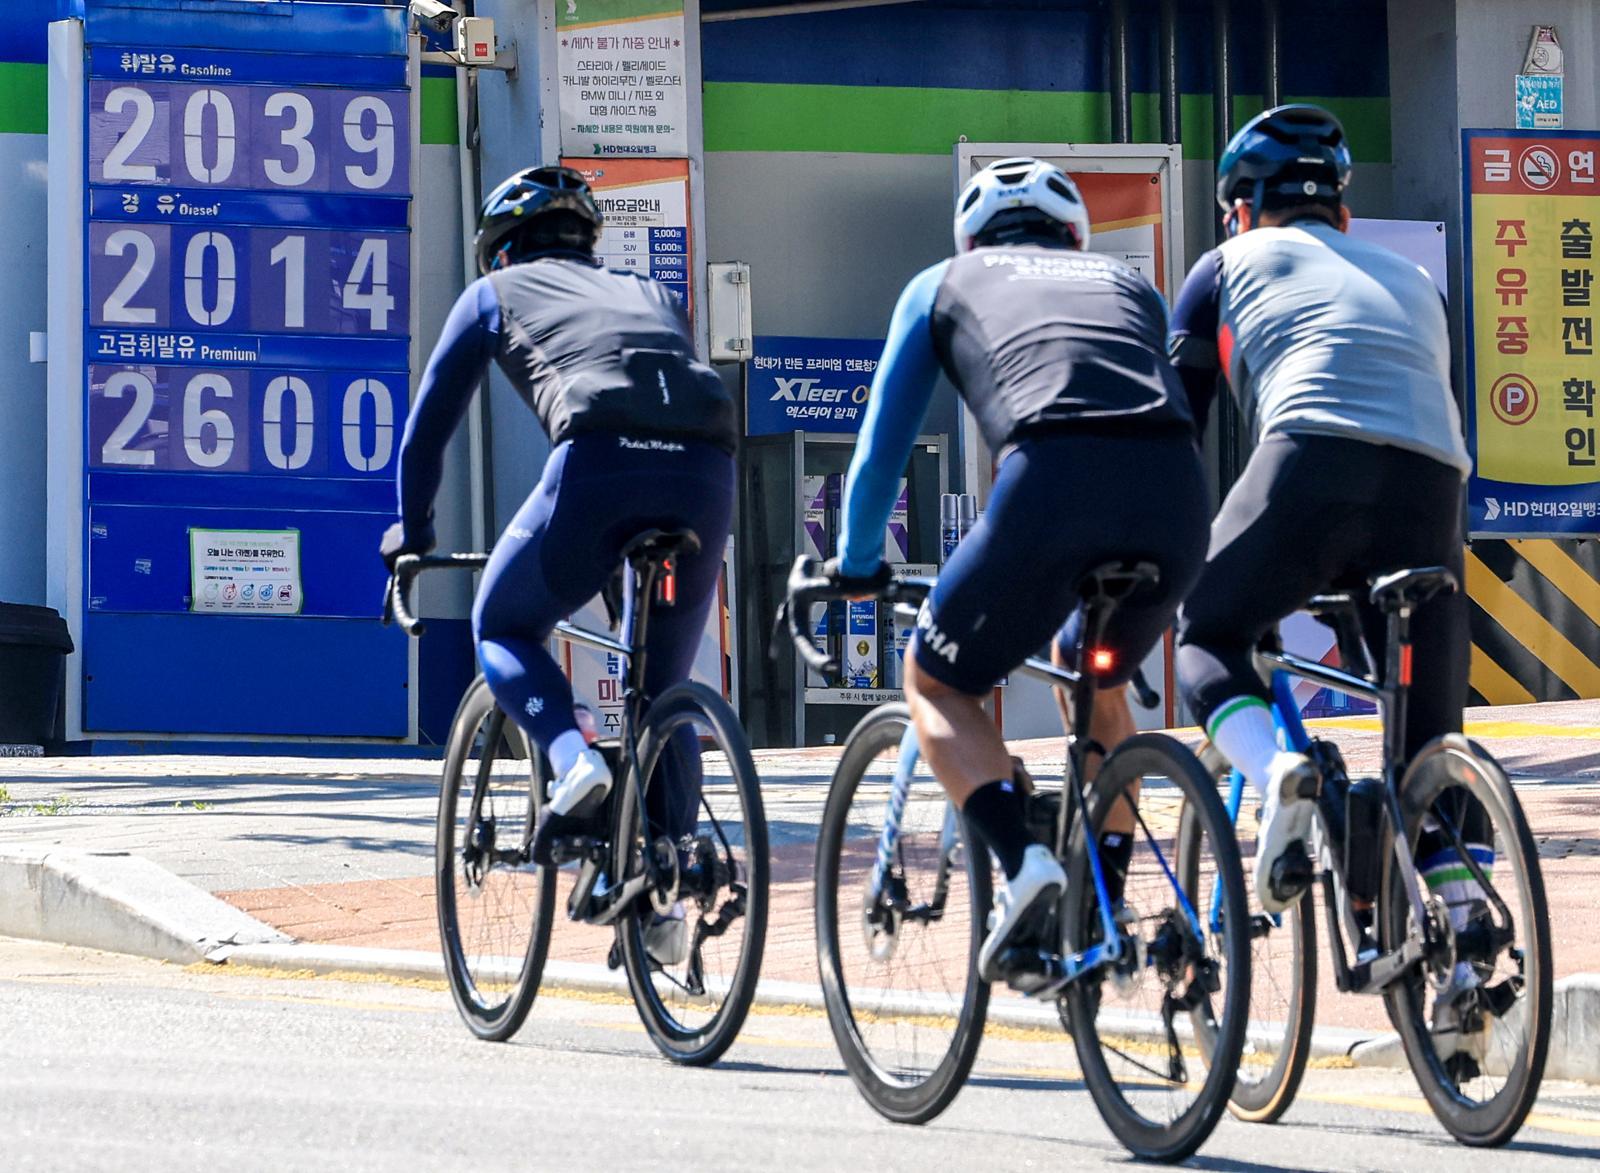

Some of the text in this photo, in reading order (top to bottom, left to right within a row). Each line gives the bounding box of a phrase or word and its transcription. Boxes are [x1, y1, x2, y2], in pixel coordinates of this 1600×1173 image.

[571, 37, 671, 49] 세차 불가 차종 안내
[120, 52, 232, 77] 휘발유 Gasoline
[577, 61, 613, 71] 스타리아
[563, 76, 590, 86] 카니발
[593, 76, 637, 86] 하이리무진
[581, 91, 606, 100] BMW
[608, 91, 626, 101] 미니
[635, 91, 653, 101] 지프
[655, 91, 664, 101] 외
[1536, 99, 1557, 110] AED
[610, 106, 637, 116] 사이즈
[102, 86, 395, 190] 2039
[1484, 149, 1511, 182] 금
[1568, 151, 1595, 184] 연
[623, 244, 637, 252] SUV
[102, 229, 395, 331] 2014
[1494, 219, 1530, 355] 주유중
[1560, 218, 1594, 356] 출발전
[98, 334, 257, 361] 고급휘발유 Premium
[753, 356, 881, 372] 현대가 만든 프리미엄 연료첨가
[770, 377, 848, 402] XTeer
[101, 371, 394, 472] 2600
[786, 406, 858, 419] 엑스티어 알파
[1562, 377, 1596, 467] 확인
[1503, 501, 1600, 519] HD현대오일뱅
